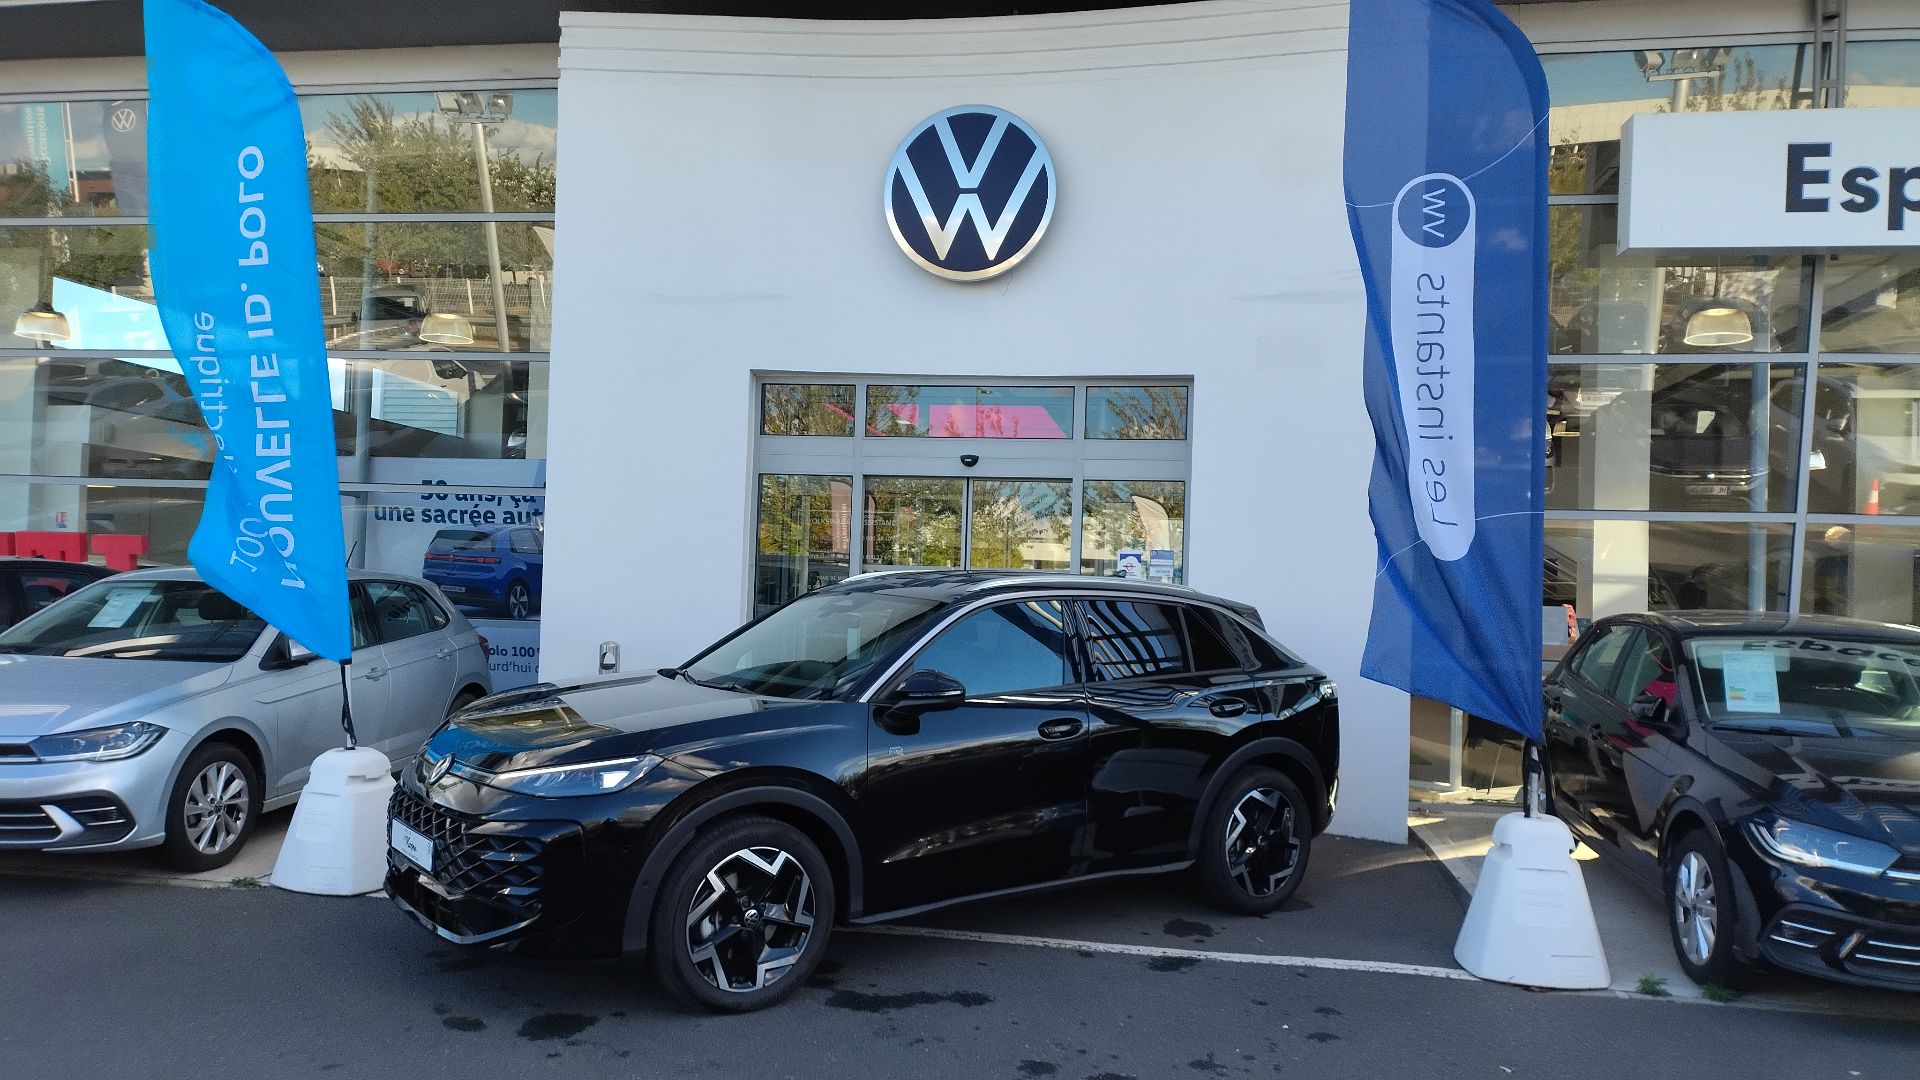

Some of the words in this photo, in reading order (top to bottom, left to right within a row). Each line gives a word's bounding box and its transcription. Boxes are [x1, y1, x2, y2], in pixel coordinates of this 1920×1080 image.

[885, 105, 1056, 280] VW
[374, 505, 415, 522] une
[421, 503, 496, 525] sacrée
[511, 646, 535, 657] 100
